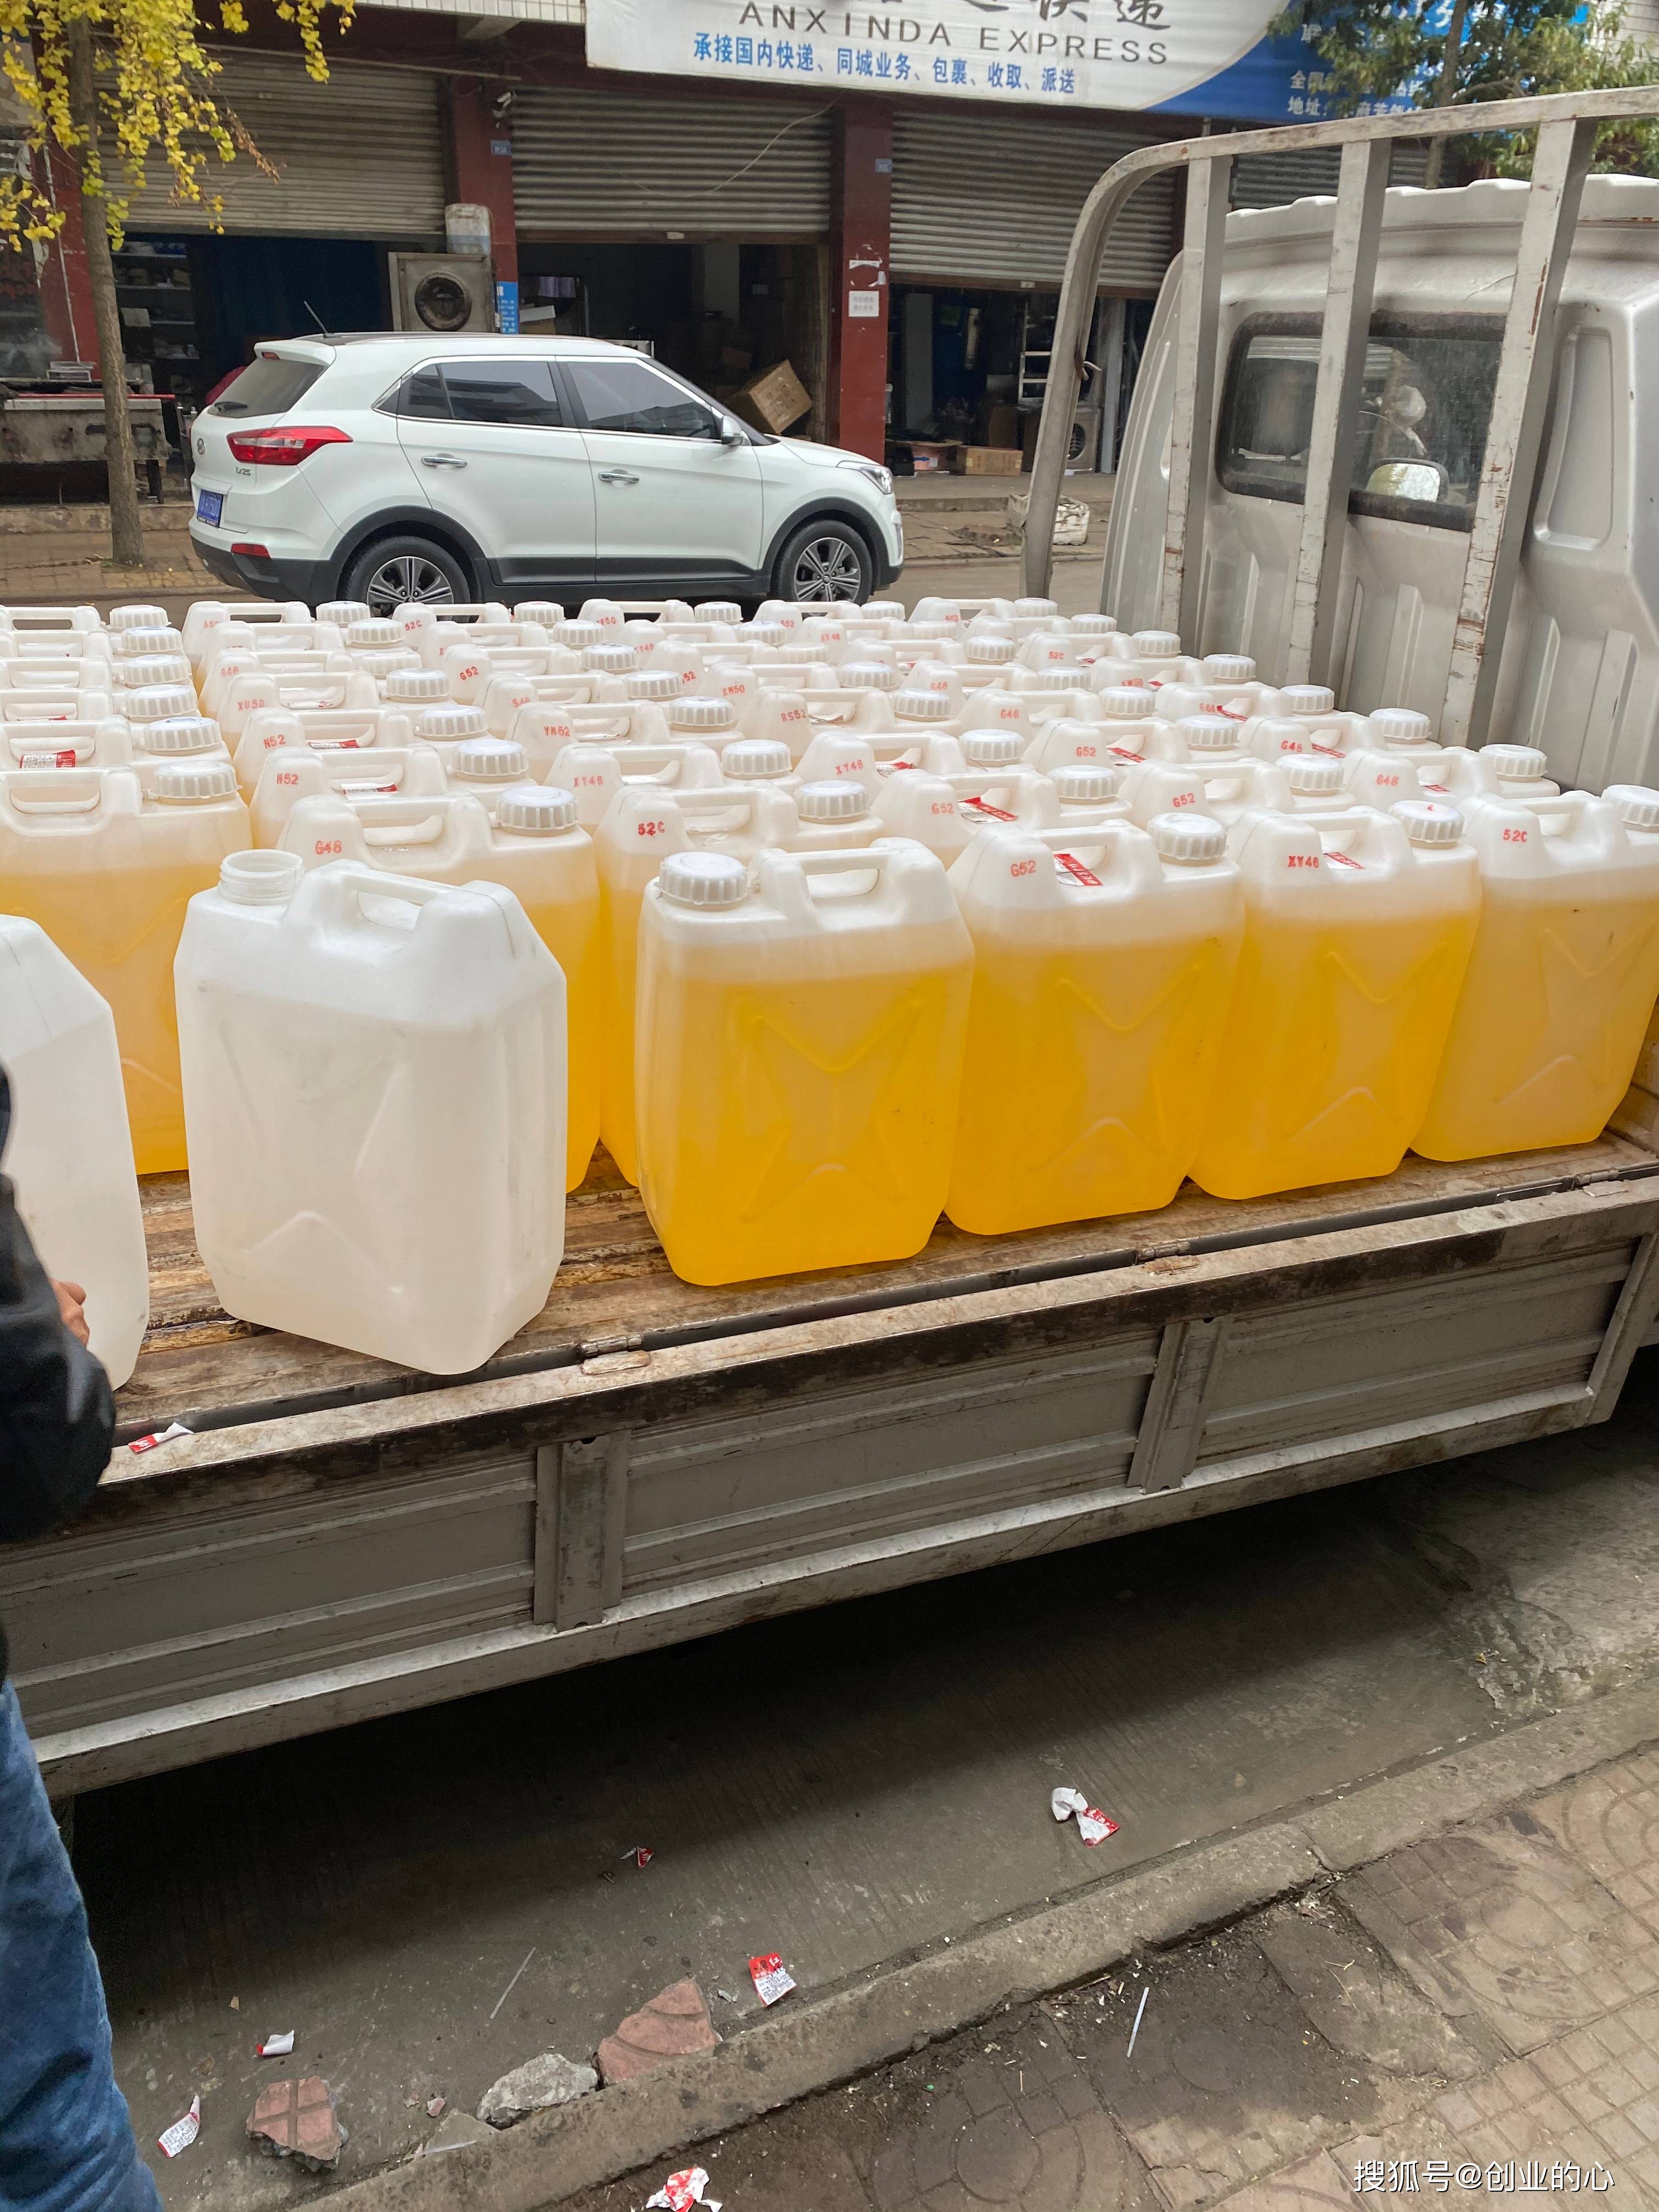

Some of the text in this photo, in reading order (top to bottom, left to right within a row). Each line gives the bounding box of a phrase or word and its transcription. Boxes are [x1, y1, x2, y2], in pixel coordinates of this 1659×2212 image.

[739, 1, 1167, 64] ANXINDA EXPRESS
[405, 619, 422, 631] 52C
[460, 666, 479, 680] G52
[682, 671, 697, 684] 52
[1076, 746, 1097, 757] G52
[1173, 793, 1196, 808] G52
[932, 803, 954, 815] G52
[637, 821, 665, 837] 52C
[1503, 828, 1528, 843] 52C
[315, 840, 343, 855] G48
[1011, 860, 1036, 877] G52
[1288, 855, 1319, 868] XY46
